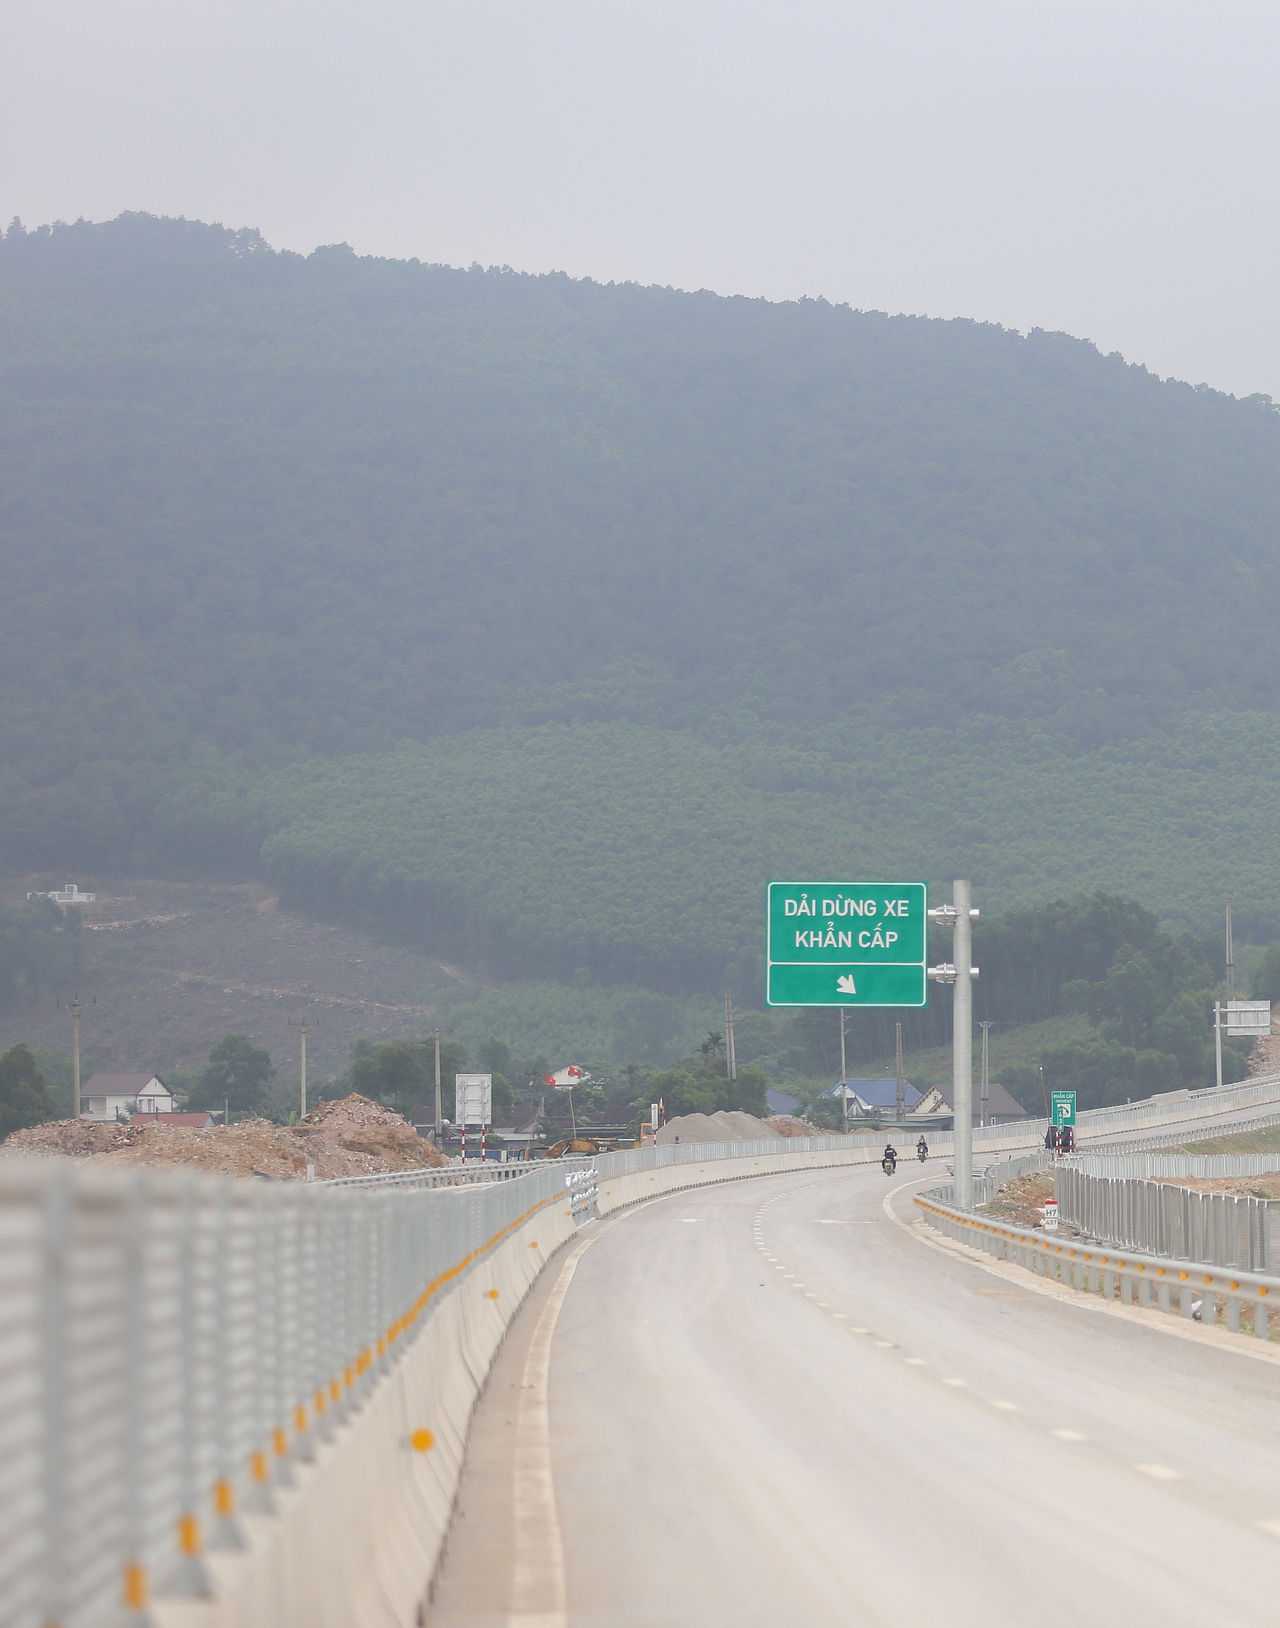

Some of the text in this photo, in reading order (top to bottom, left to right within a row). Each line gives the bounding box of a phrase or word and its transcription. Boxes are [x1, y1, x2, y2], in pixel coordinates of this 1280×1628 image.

[784, 893, 910, 917] DẢI DỪNG XE
[795, 921, 899, 949] KHẨN CẤP
